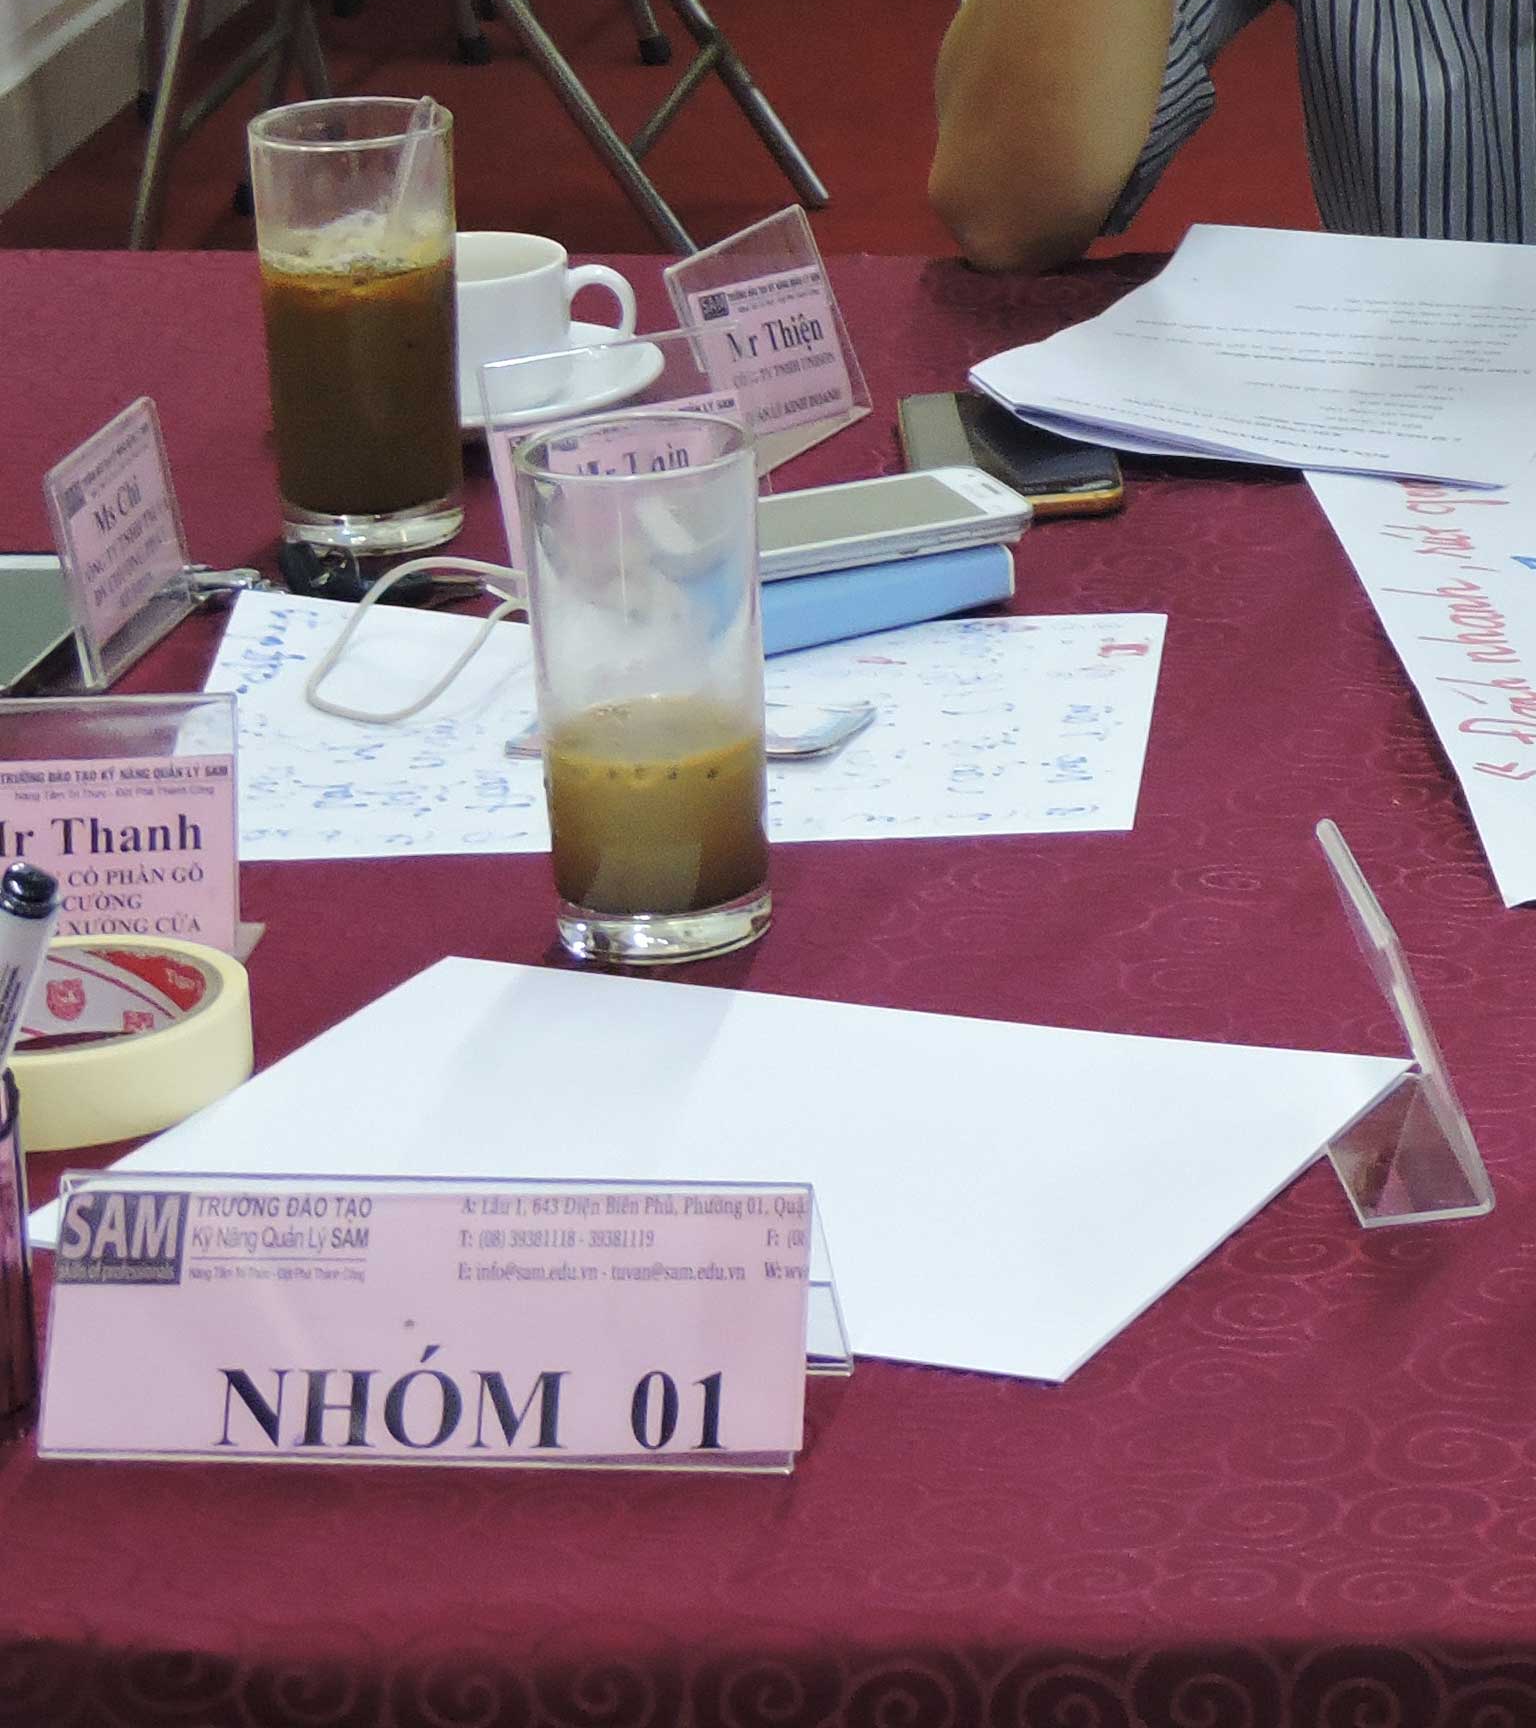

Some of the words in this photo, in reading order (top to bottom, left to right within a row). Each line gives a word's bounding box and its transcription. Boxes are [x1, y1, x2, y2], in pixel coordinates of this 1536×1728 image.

[763, 313, 824, 352] Thiện
[51, 813, 202, 855] Thanh
[60, 1193, 182, 1260] SAM
[197, 1192, 280, 1218] TRƯỜNG
[286, 1193, 328, 1218] ĐÀO
[337, 1195, 373, 1223] TẠO
[532, 1198, 559, 1216] 643
[331, 1226, 369, 1249] SAM
[217, 1343, 573, 1449] NHÓM
[630, 1370, 729, 1450] 01
